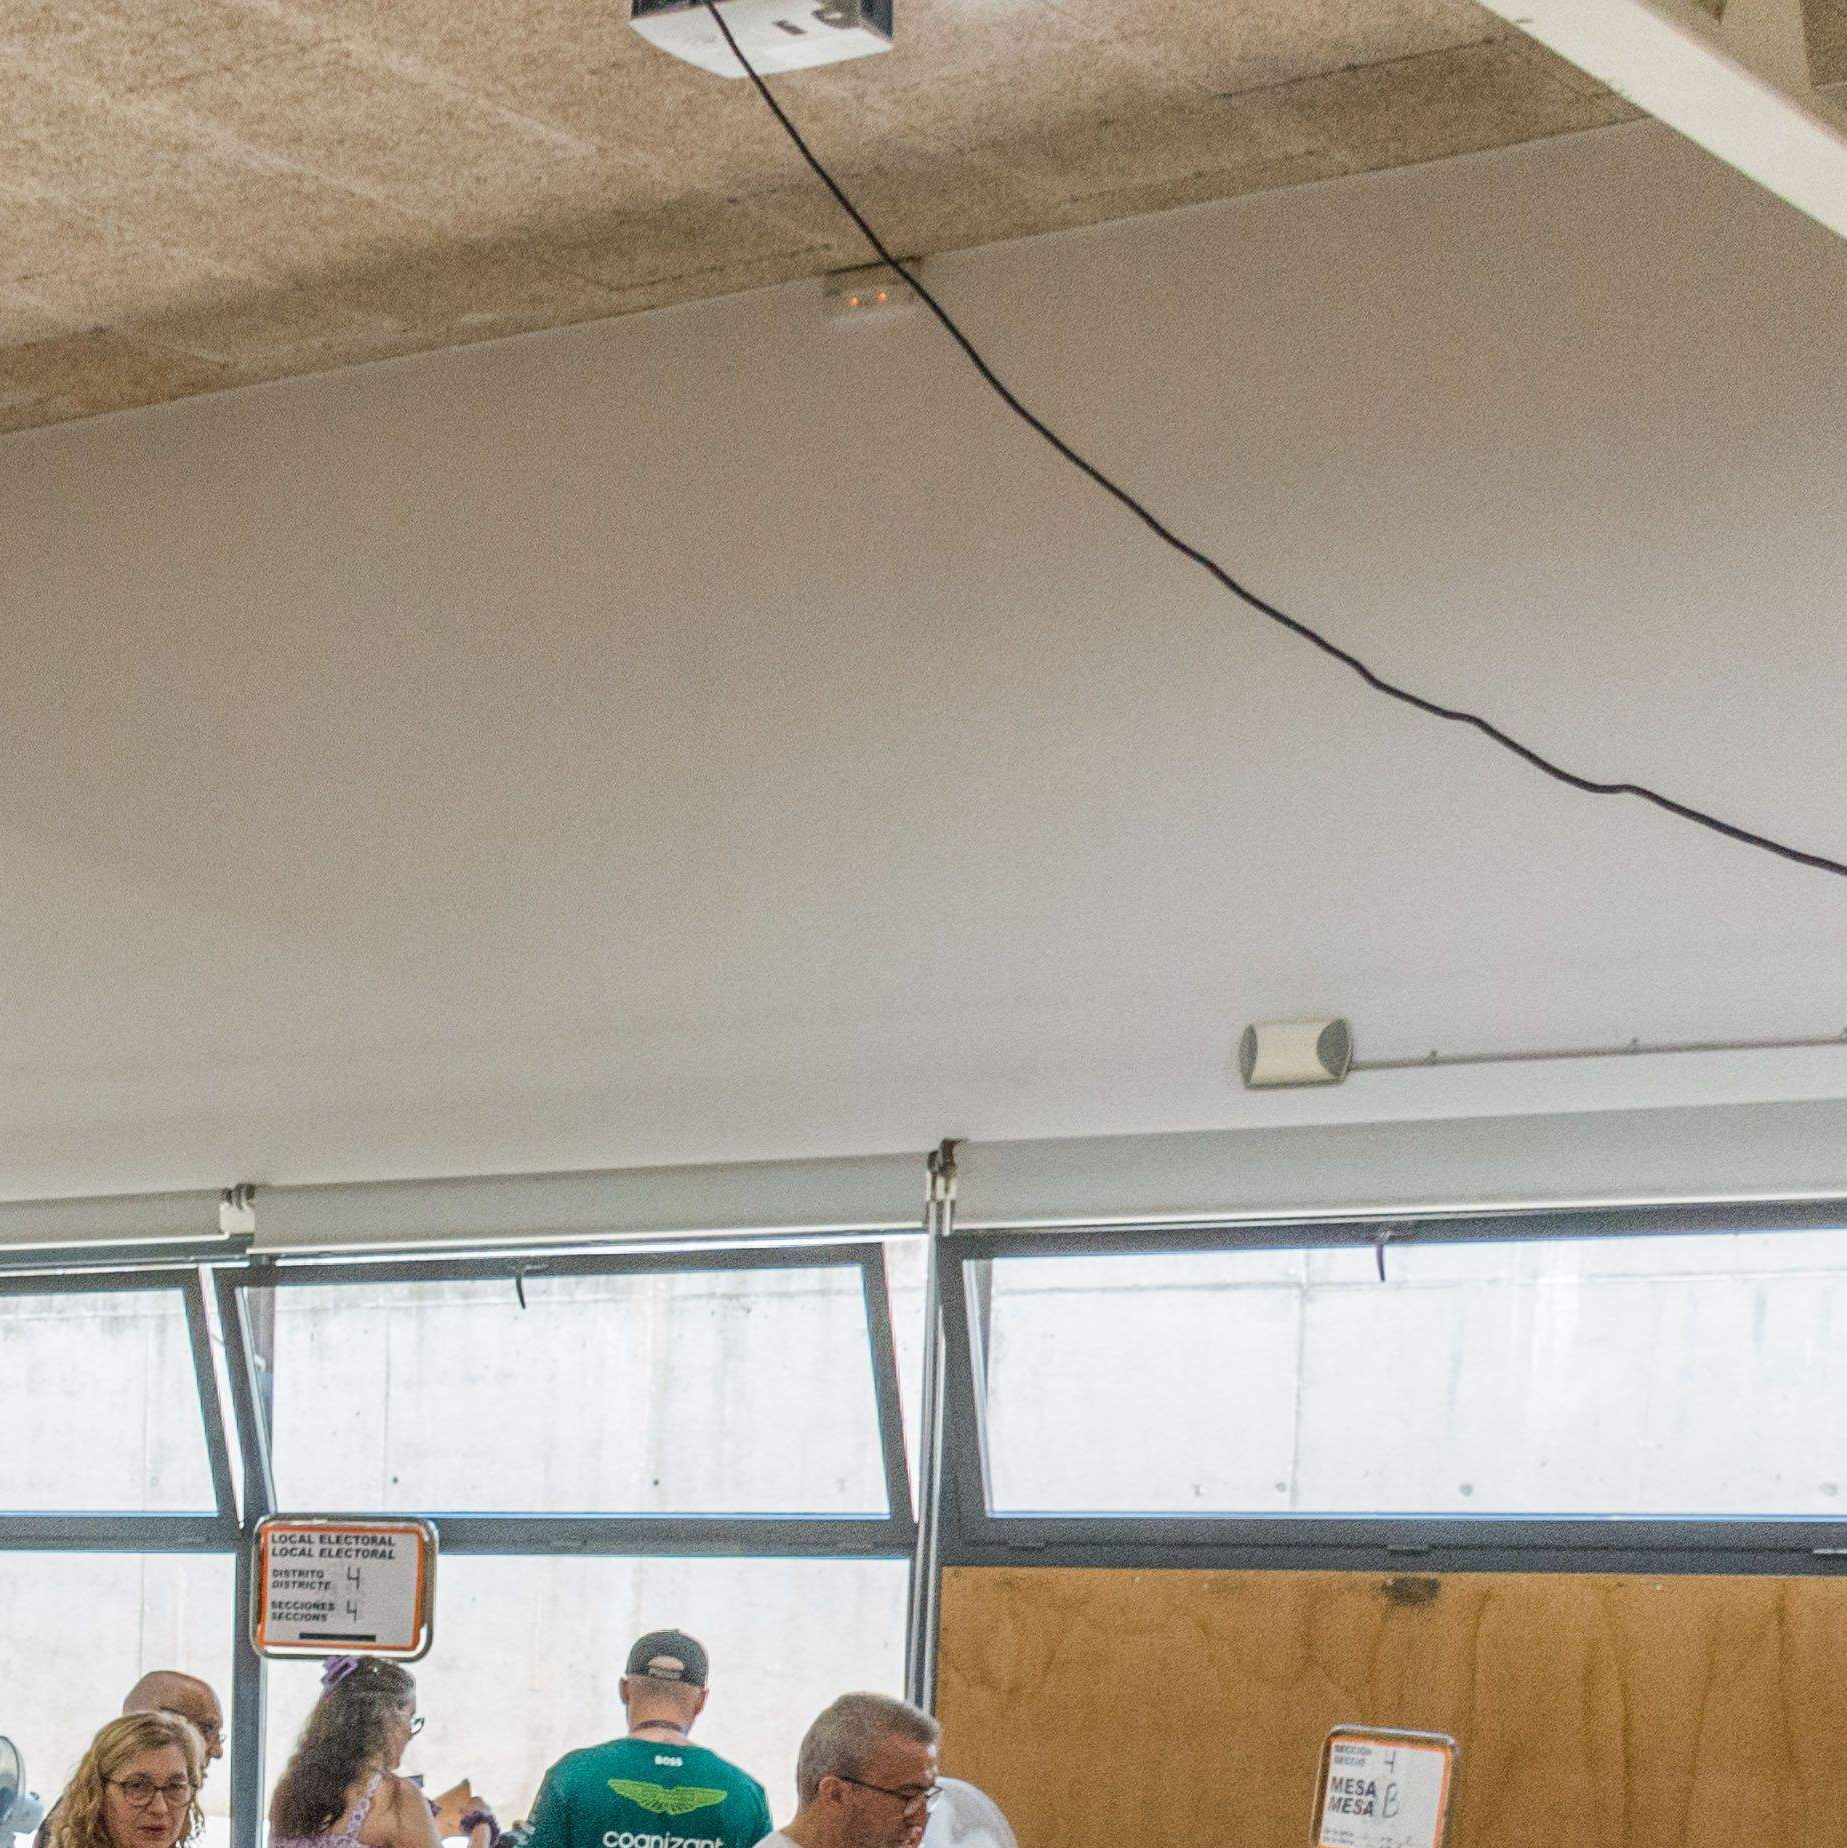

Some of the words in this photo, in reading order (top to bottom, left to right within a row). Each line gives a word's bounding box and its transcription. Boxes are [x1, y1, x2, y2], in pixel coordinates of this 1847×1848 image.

[271, 1534, 315, 1546] LOCAL
[319, 1535, 396, 1547] ELECTORAL
[271, 1547, 315, 1559] LOCAL
[319, 1548, 396, 1560] ELECTORAL
[272, 1568, 325, 1579] DISTRITO
[347, 1566, 361, 1590] 4
[271, 1579, 332, 1591] DISTRICTE
[271, 1601, 335, 1612] SECCIONES
[346, 1600, 358, 1622] 4
[271, 1612, 328, 1622] SECCIONS
[1384, 1750, 1396, 1774] 4
[1330, 1776, 1377, 1798] MESA
[1328, 1796, 1374, 1817] MESA
